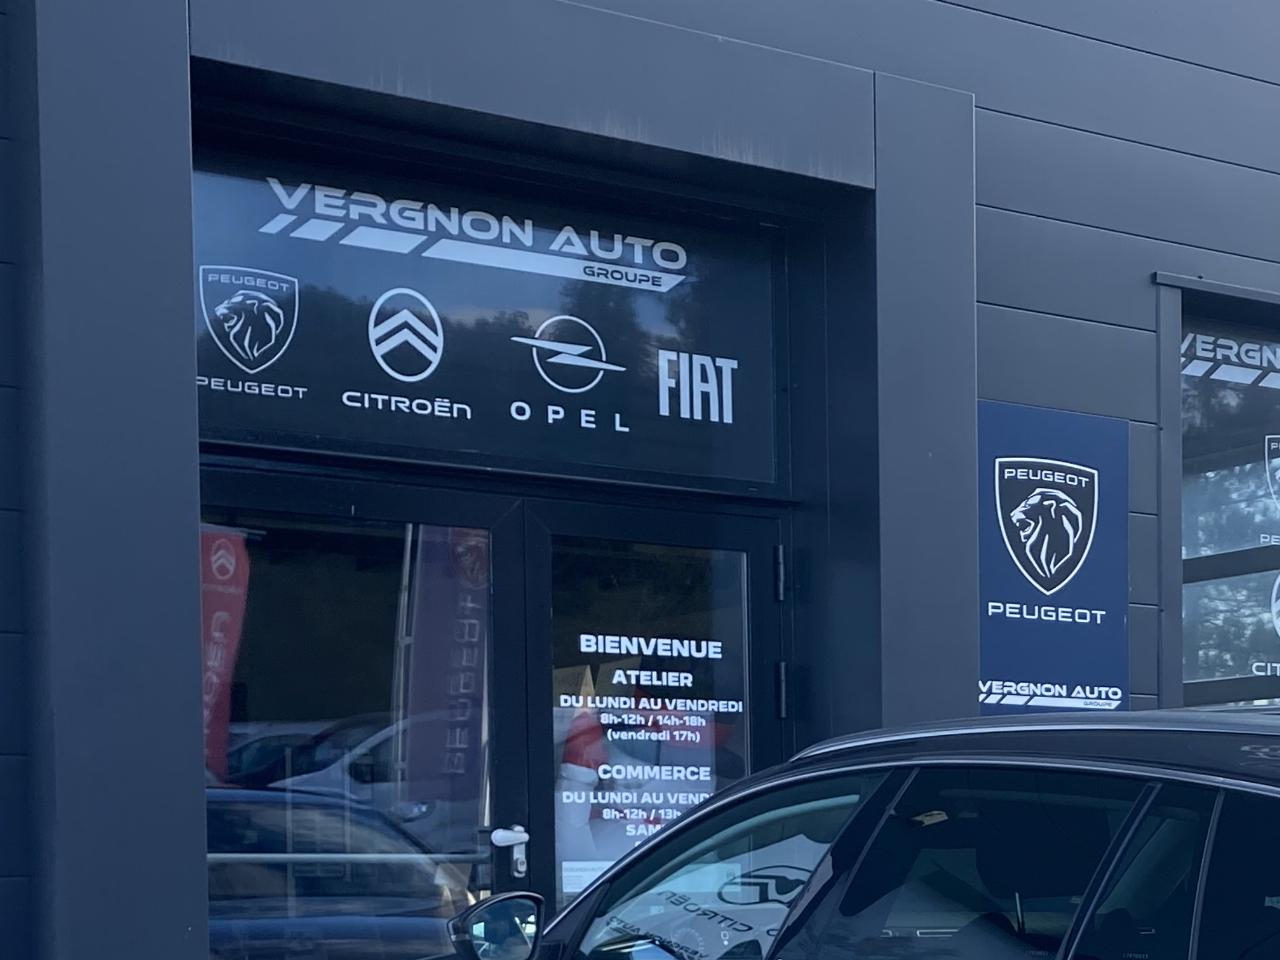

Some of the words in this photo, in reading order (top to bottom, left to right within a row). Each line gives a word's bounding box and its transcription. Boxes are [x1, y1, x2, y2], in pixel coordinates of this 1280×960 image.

[266, 177, 533, 247] VERGNON
[549, 226, 688, 269] AUTO
[208, 273, 290, 292] PEUGEOT
[583, 266, 662, 287] GROUPE
[658, 349, 738, 424] FIAT
[511, 401, 630, 432] OPEL
[1004, 468, 1090, 488] PEUGEOT
[988, 602, 1106, 624] PEUGEOT
[580, 634, 722, 659] BIENVENUE
[612, 669, 693, 687] ATELIER
[979, 680, 1067, 697] VERGNON
[1071, 685, 1122, 700] AUTO
[560, 694, 583, 707] DU
[587, 696, 635, 709] LUNDI
[638, 697, 662, 710] AU
[665, 698, 743, 712] VENDREDI
[600, 714, 645, 725] 8h-12h
[657, 715, 706, 727] 14h-18h
[607, 728, 670, 741] (vendredi
[673, 730, 700, 743] 17h)
[598, 764, 711, 781] COMMERCE
[562, 791, 585, 804] DU
[589, 791, 637, 804] LUNDI
[641, 792, 663, 804] AU
[602, 808, 647, 819] 8h-12h
